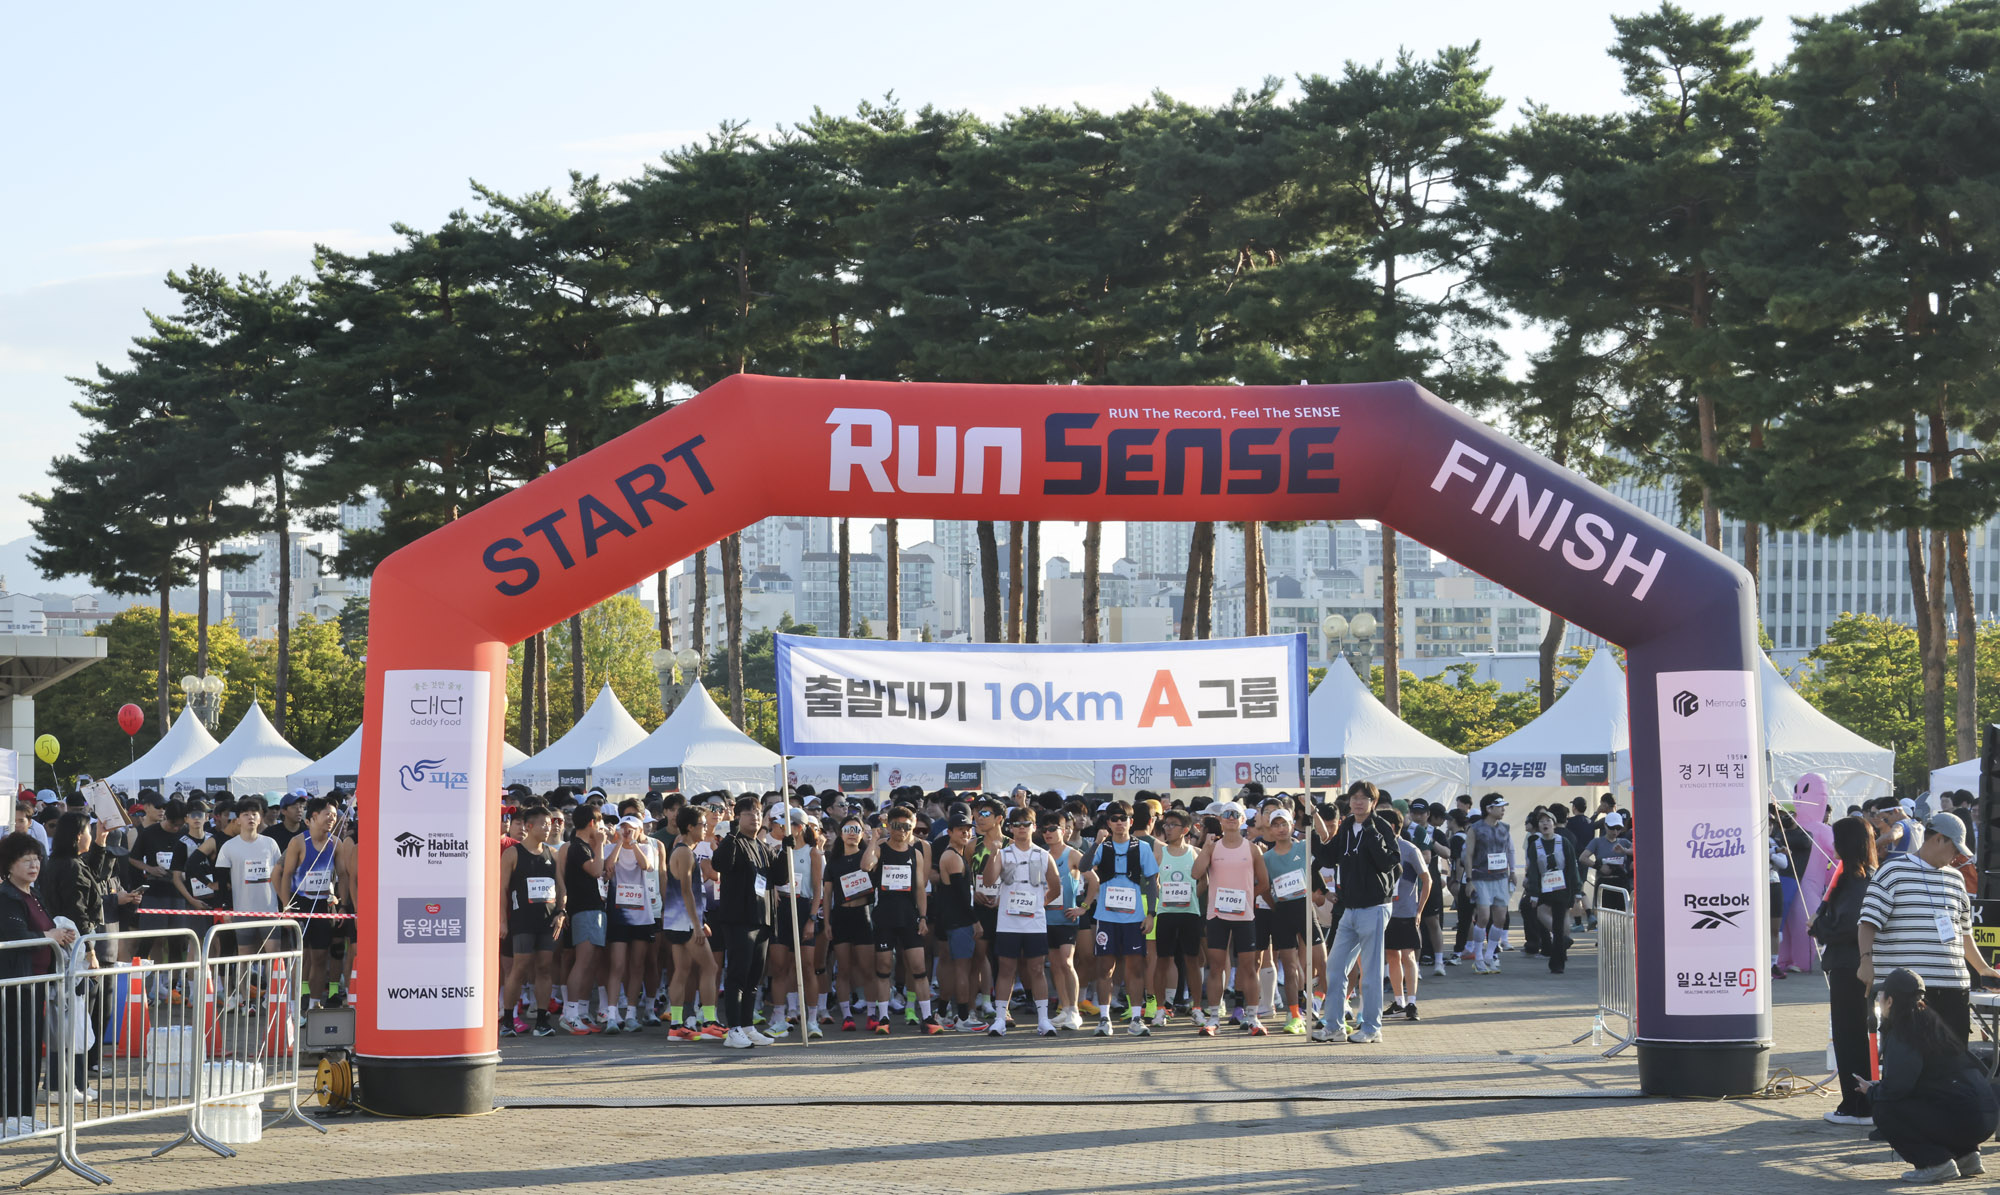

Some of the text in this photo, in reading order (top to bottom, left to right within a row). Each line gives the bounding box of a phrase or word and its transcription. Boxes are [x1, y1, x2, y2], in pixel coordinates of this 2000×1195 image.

[1109, 406, 1341, 420] RUN The Record, Feel The SENSE
[482, 434, 715, 597] START
[1430, 440, 1667, 601] FINISH
[804, 674, 967, 722] 출발대기
[985, 681, 1123, 721] 10km
[410, 695, 464, 716] 대디
[410, 717, 462, 728] daddy food
[1128, 764, 1153, 777] Short
[1254, 762, 1280, 775] Short
[1497, 761, 1547, 781] 오늘덤핑
[1679, 763, 1745, 781] 경기떡집
[428, 771, 469, 790] 피죤
[1691, 822, 1743, 841] Choco
[428, 839, 469, 851] Habitat
[1686, 837, 1747, 859] Health
[439, 850, 469, 859] Humanity
[850, 877, 867, 888] 2570
[1284, 878, 1300, 888] 1401
[625, 891, 642, 899] 2019
[1016, 898, 1034, 906] 1234
[1116, 894, 1133, 902] 1411
[1225, 896, 1242, 904] 1061
[1683, 893, 1750, 909] Reebok
[402, 918, 462, 938] 동원샘물
[1676, 971, 1738, 988] 일요신문
[387, 986, 475, 1000] WOMAN SENSE
